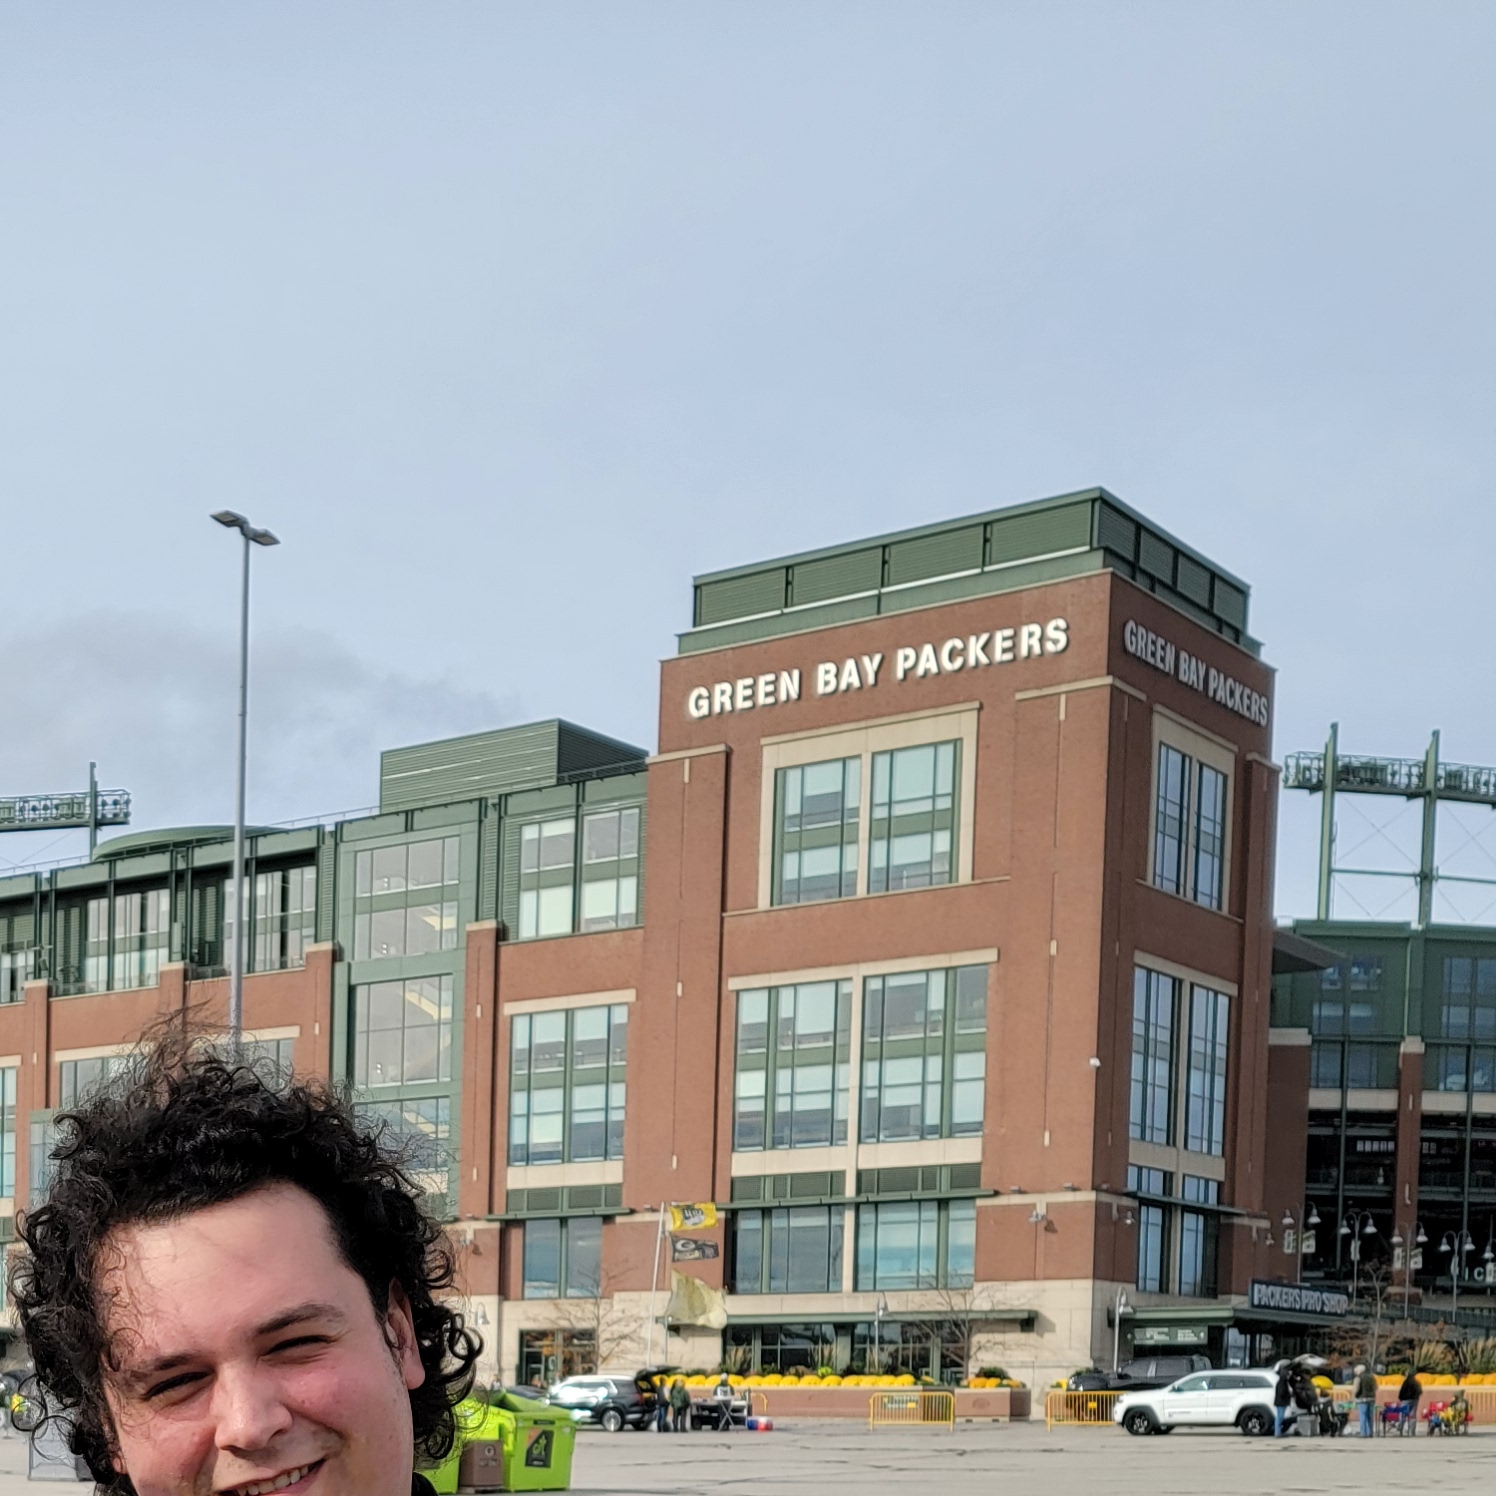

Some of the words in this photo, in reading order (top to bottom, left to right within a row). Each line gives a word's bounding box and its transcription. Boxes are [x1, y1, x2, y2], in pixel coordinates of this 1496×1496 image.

[688, 668, 801, 719] GREEN
[816, 652, 883, 695] BAY
[895, 617, 1069, 682] PACKERS
[1124, 619, 1176, 675] GREEN
[1178, 650, 1207, 692] BAY
[1208, 667, 1269, 727] PACKERS
[1253, 1283, 1302, 1310] PACKERS
[1301, 1289, 1322, 1313] PRO
[1322, 1292, 1349, 1315] SHOP
